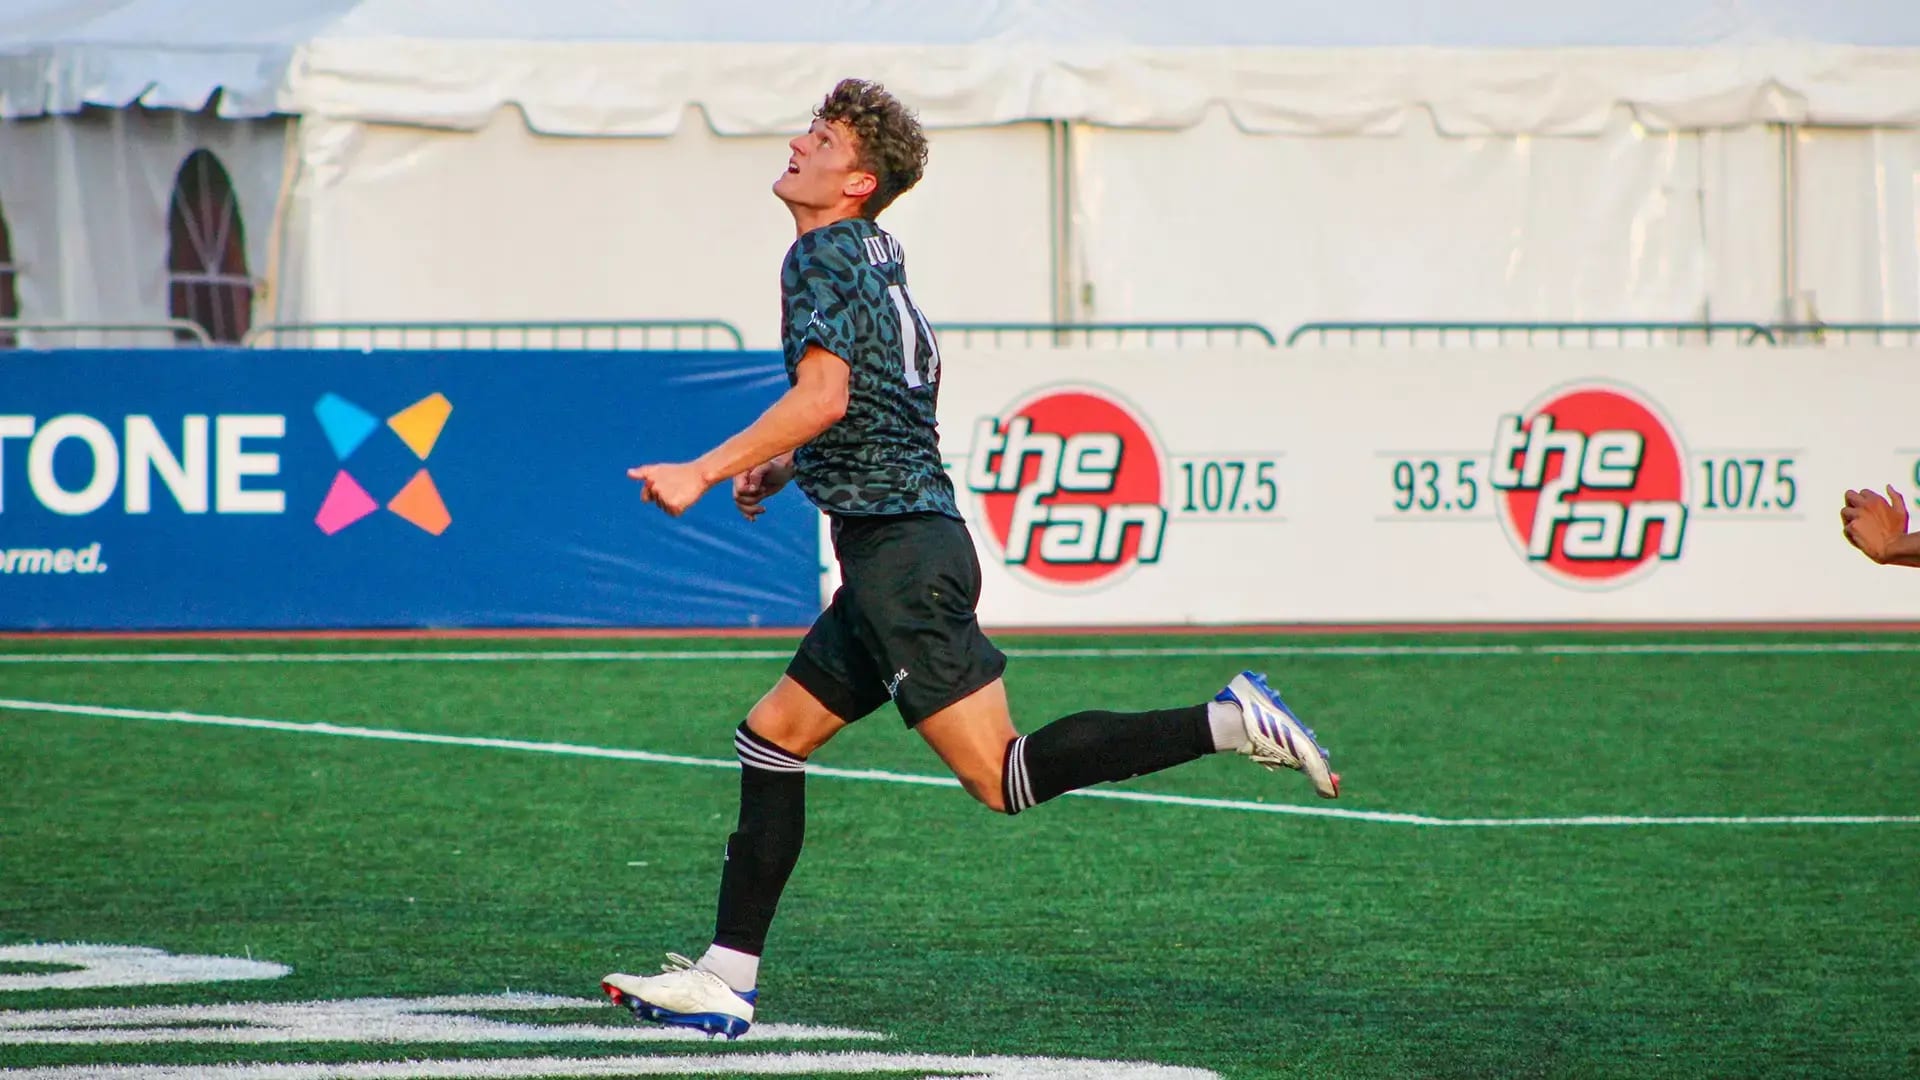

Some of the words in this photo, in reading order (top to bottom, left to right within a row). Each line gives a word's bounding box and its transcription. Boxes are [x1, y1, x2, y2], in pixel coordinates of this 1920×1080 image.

[0, 413, 286, 516] ONE
[967, 415, 1124, 493] the
[1181, 461, 1278, 513] 107.5
[1393, 460, 1478, 511] 93.5
[1490, 413, 1645, 490] the
[1700, 459, 1796, 509] 107.5
[0, 542, 108, 574] rmed.
[1004, 480, 1168, 565] fan
[1527, 479, 1688, 562] fan
